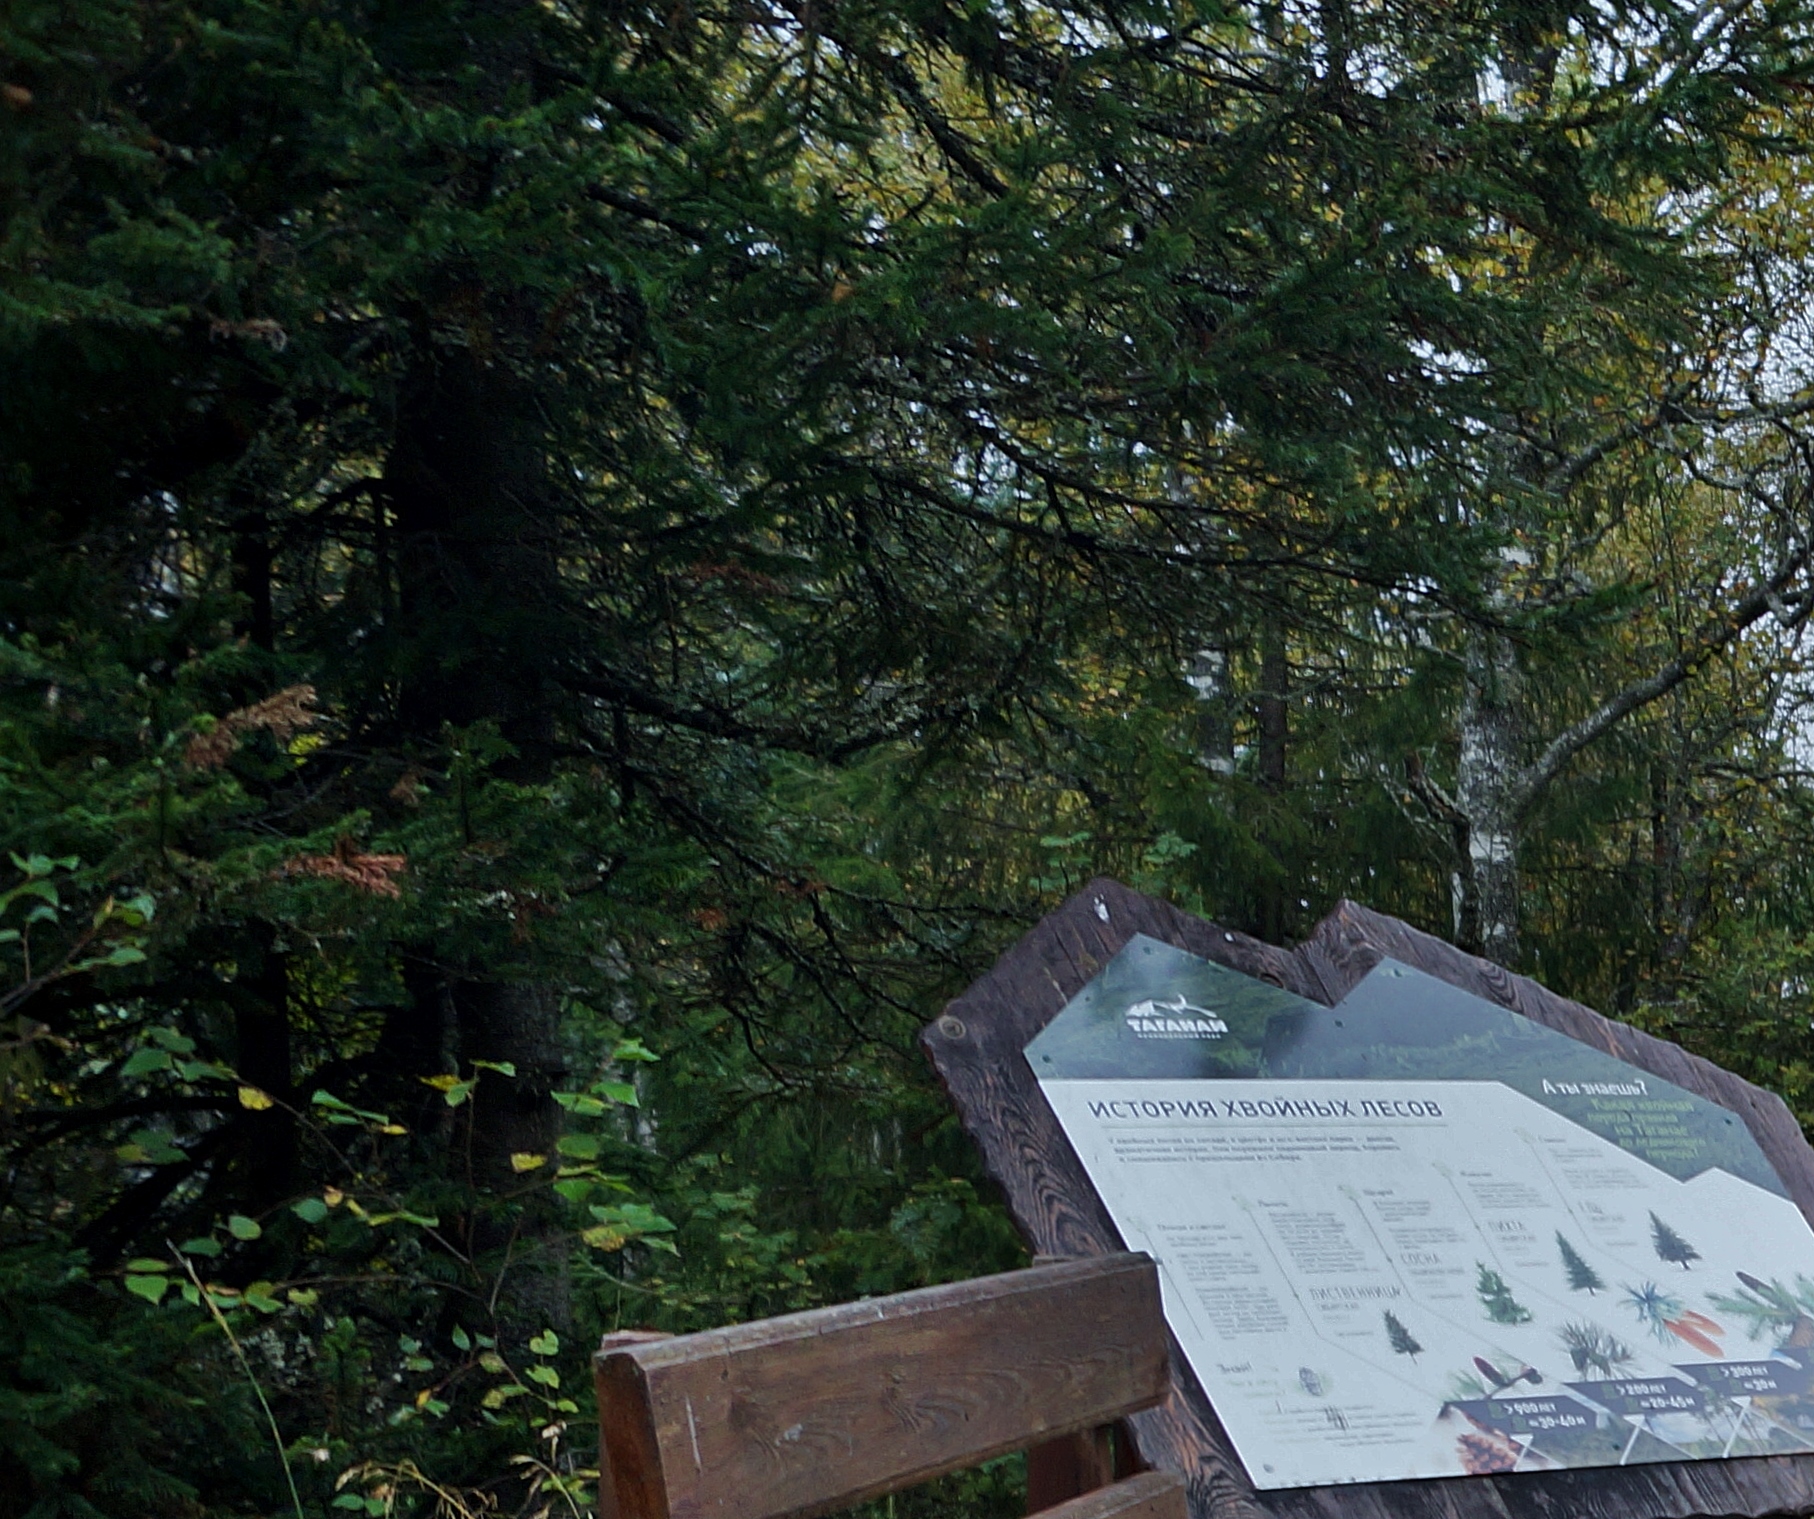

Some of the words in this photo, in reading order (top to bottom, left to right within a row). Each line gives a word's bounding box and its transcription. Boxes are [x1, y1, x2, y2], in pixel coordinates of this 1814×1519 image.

[1542, 1078, 1556, 1095] А
[1557, 1082, 1578, 1095] ты
[1582, 1078, 1648, 1097] знаешь?
[1088, 1100, 1217, 1119] ИСТОРИЯ
[1221, 1096, 1355, 1119] ХВОЙНЫХ
[1361, 1099, 1443, 1118] ЛЕСОВ
[1632, 1123, 1688, 1137] Таганае
